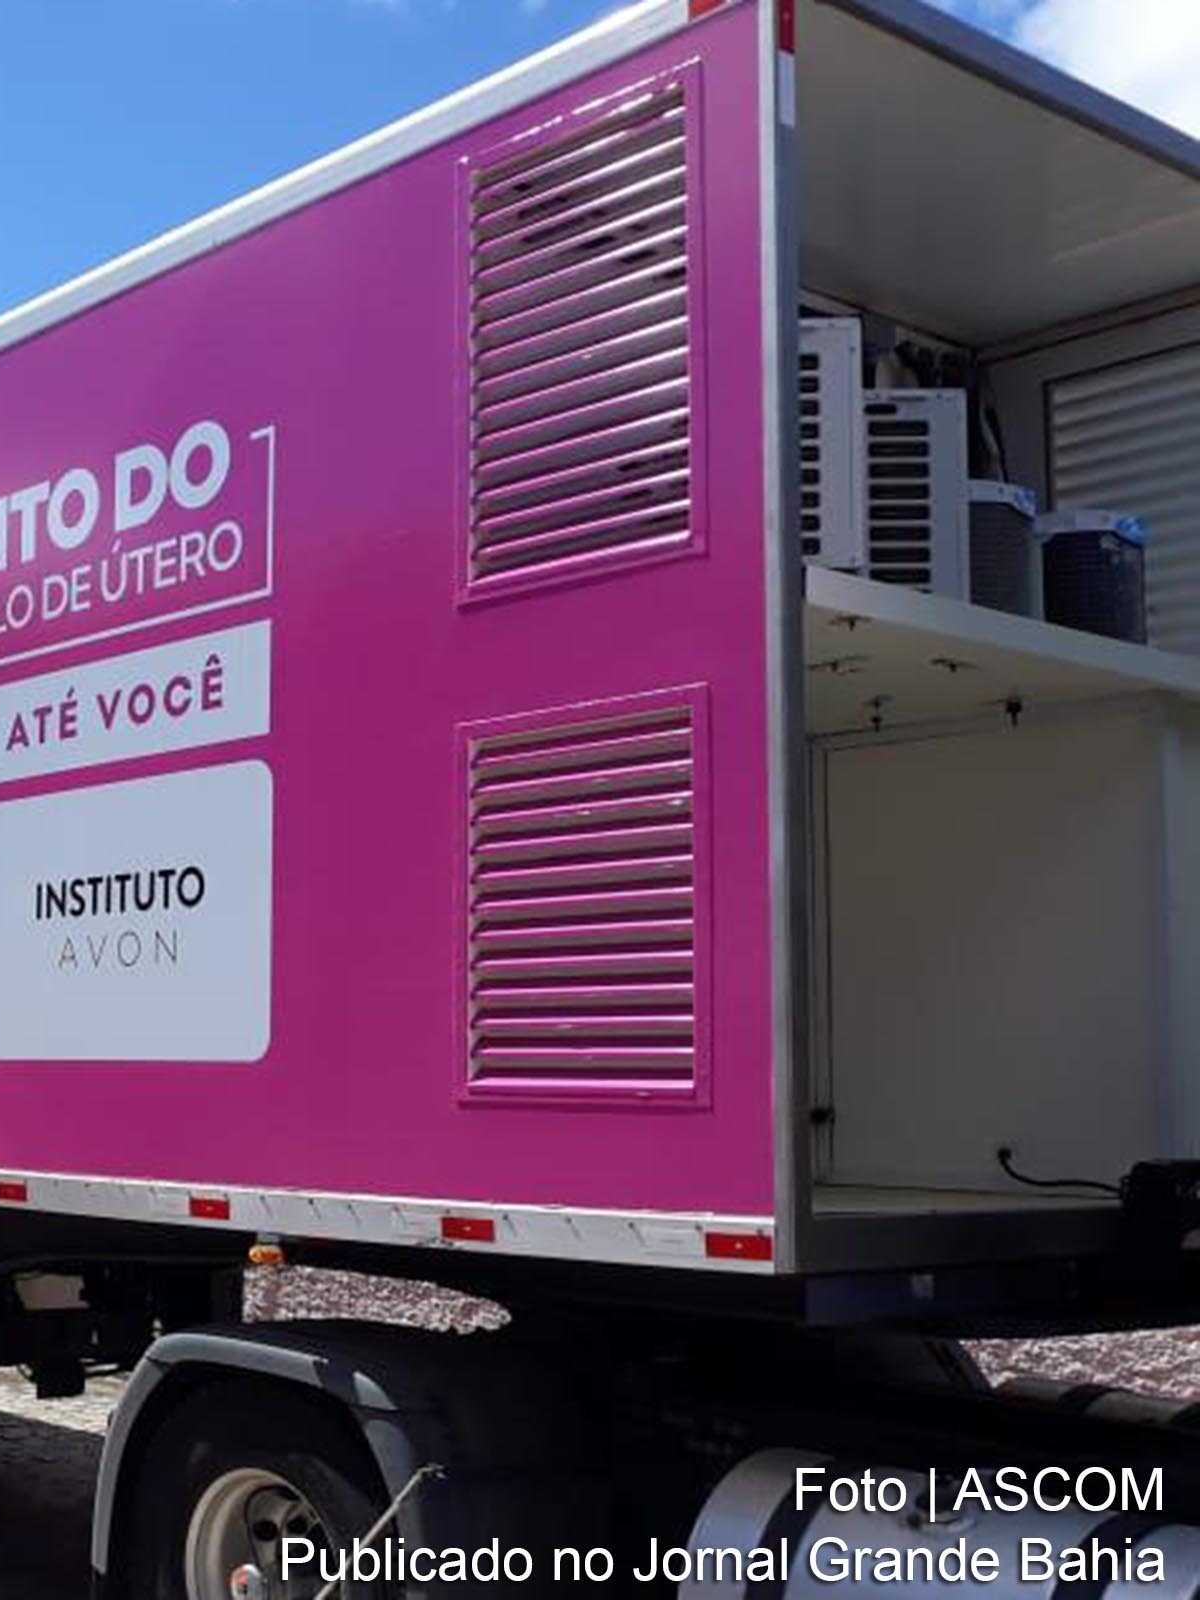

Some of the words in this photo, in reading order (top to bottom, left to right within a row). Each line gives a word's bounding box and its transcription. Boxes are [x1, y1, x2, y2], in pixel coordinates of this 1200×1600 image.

[114, 420, 230, 532] DO
[42, 564, 91, 620] DE
[101, 520, 243, 602] ÚTERO
[6, 686, 78, 751] ATÉ
[95, 653, 223, 731] VOCÊ
[36, 866, 205, 920] INSTITUTO
[58, 929, 178, 969] AVON
